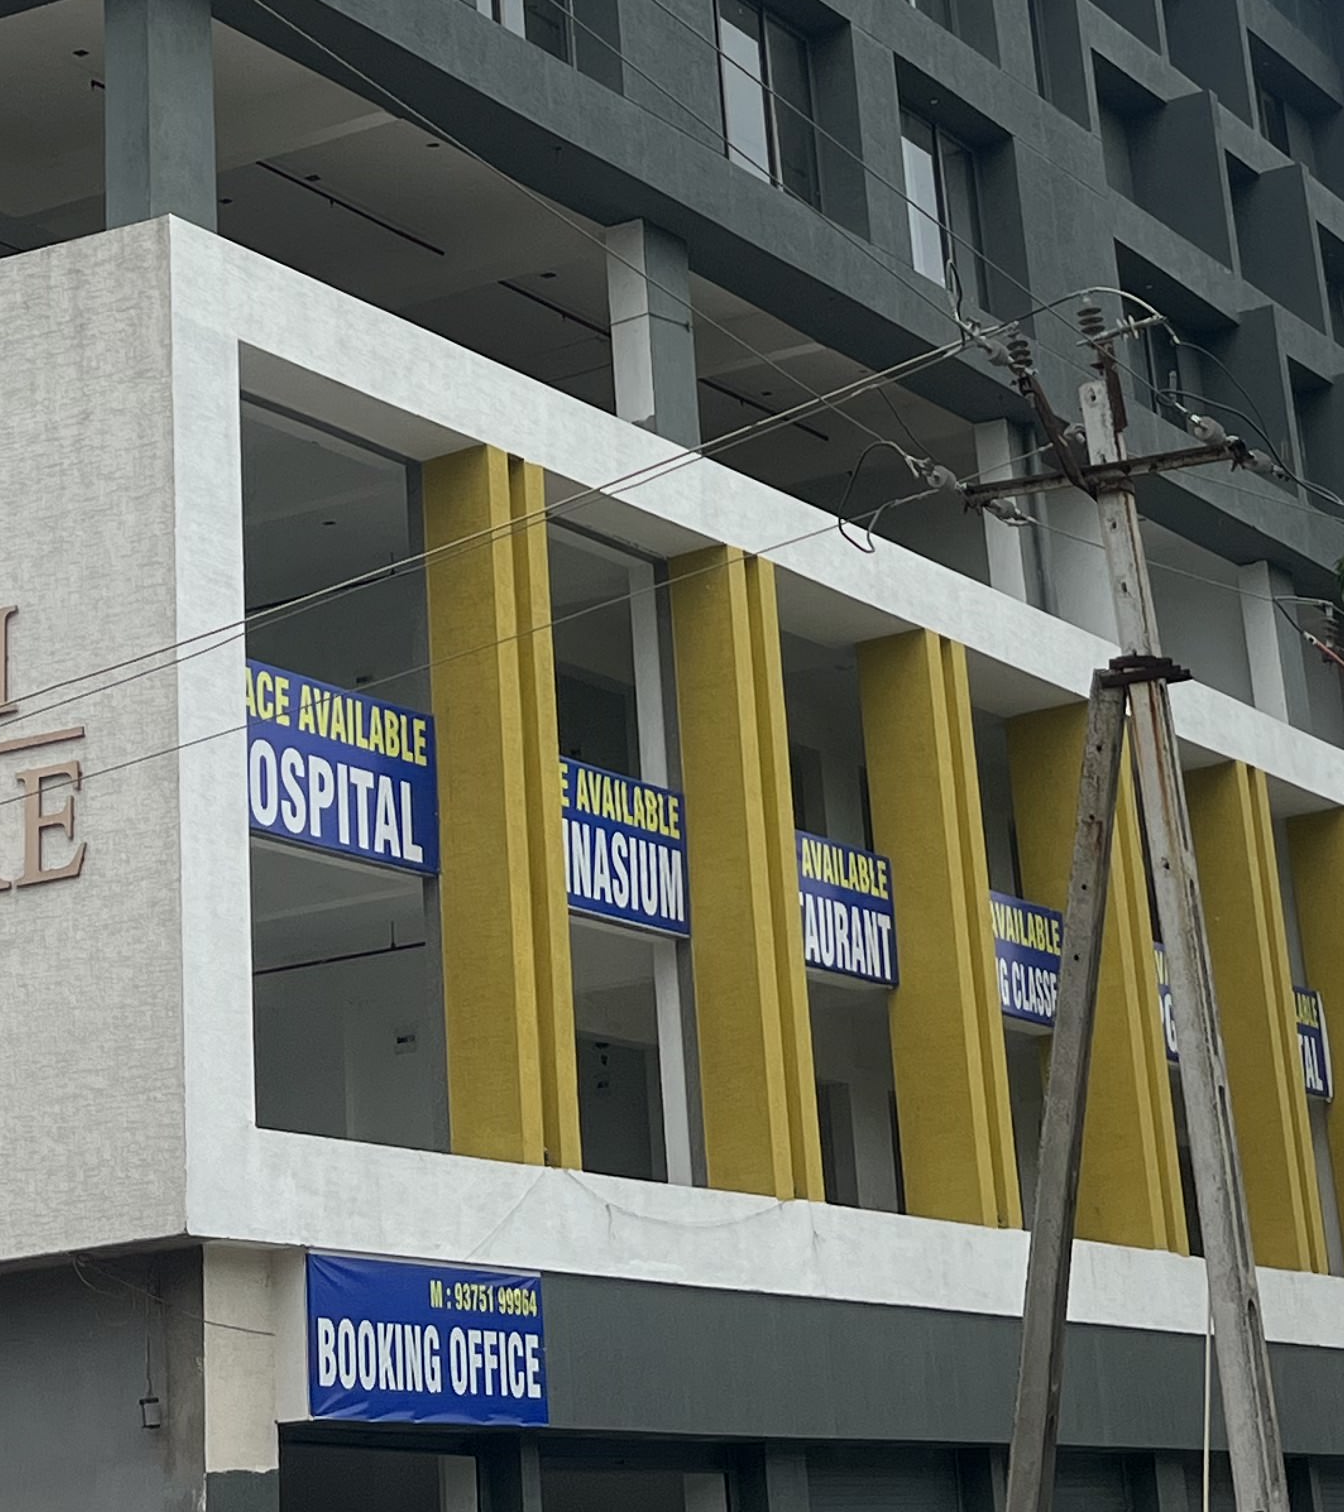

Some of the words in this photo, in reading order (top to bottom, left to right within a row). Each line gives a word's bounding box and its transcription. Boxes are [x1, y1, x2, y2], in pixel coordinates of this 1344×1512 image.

[299, 684, 428, 767] AVAILABLE
[250, 739, 424, 864] OSPITAL
[577, 768, 681, 840] AVAILABLE
[801, 838, 889, 900] AVAILABLE
[799, 891, 892, 980] AURANT
[996, 957, 1010, 1007] G
[430, 1279, 443, 1308] M
[454, 1282, 494, 1313] 93751
[498, 1286, 538, 1317] 99964
[317, 1317, 442, 1394] BOOKING
[449, 1326, 542, 1399] OFFICE
